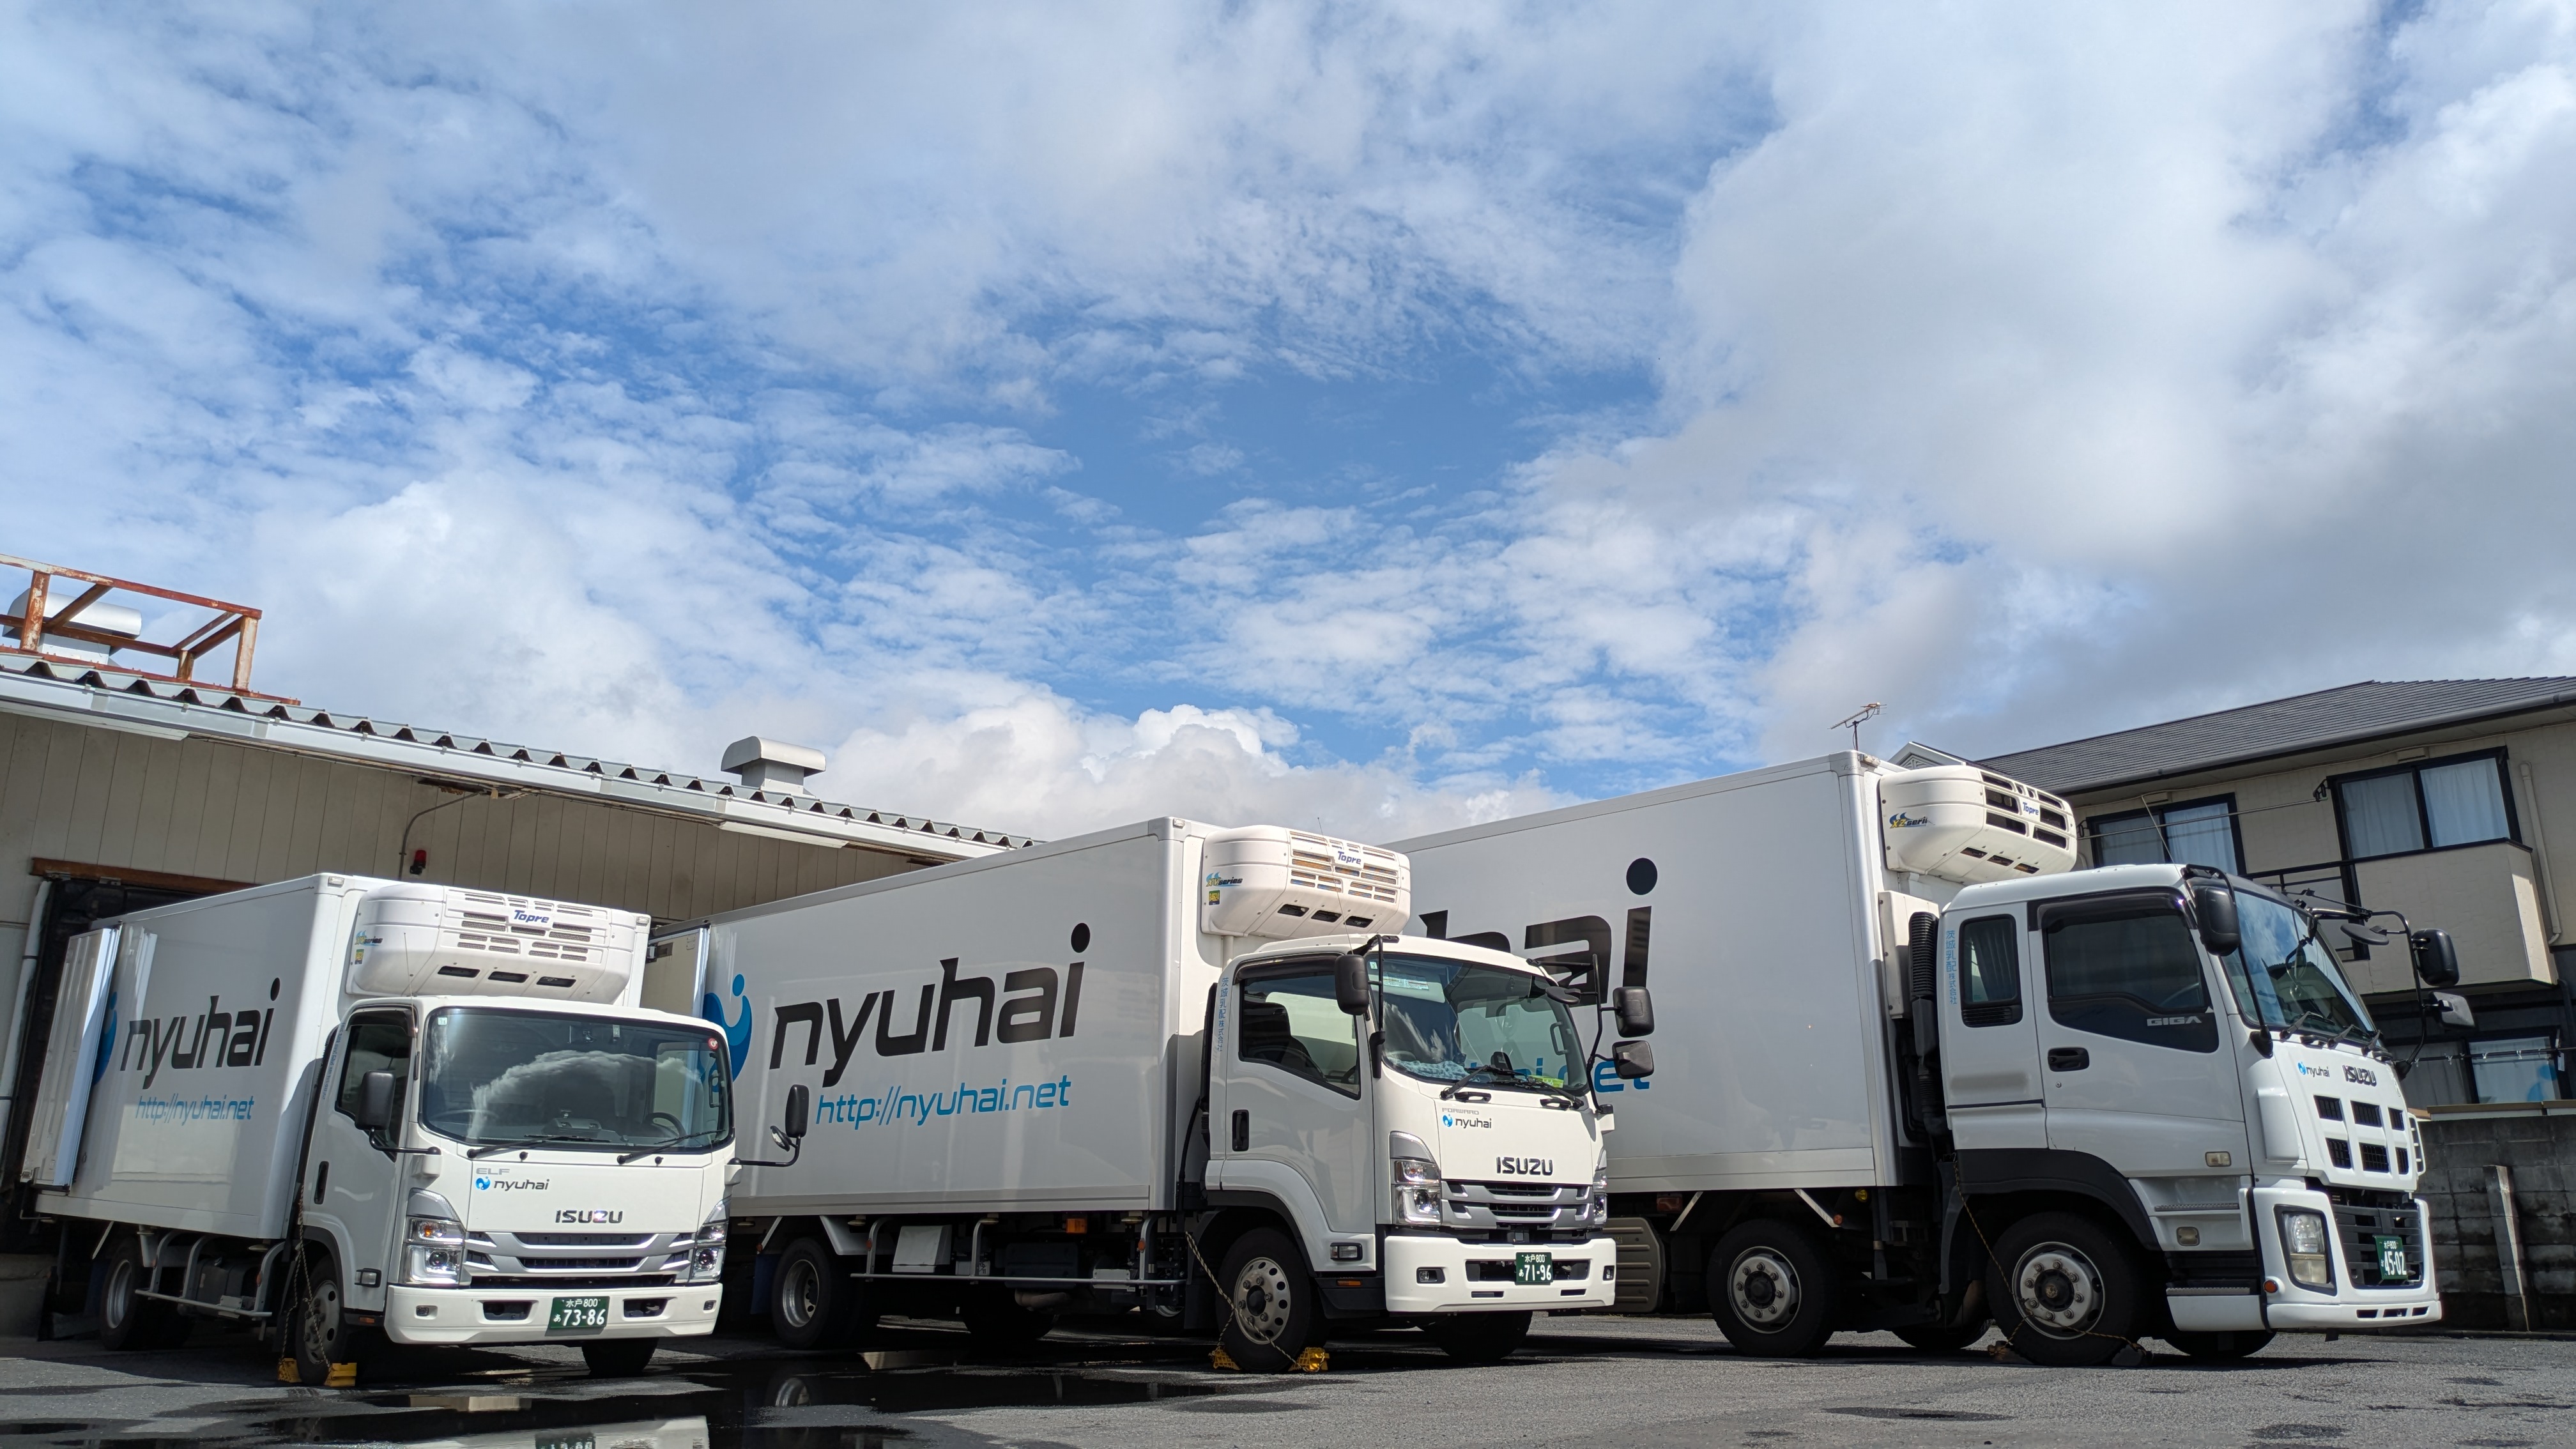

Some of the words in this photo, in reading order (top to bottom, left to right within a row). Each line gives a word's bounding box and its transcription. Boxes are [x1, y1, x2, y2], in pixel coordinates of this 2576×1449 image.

[2023, 802, 2039, 815] Topre
[1338, 851, 1361, 865] Topre
[514, 910, 549, 923] Topre
[1945, 930, 1957, 1004] 茨城乳配株式会社
[769, 923, 1091, 1088] nyuhai
[2147, 1016, 2202, 1027] GIGA
[119, 977, 280, 1090] nyuhai
[2306, 1066, 2330, 1077] nyuhai
[2342, 1064, 2377, 1087] ISUZU
[135, 1093, 255, 1126] http://nyuhai.net
[816, 1075, 1071, 1130] http://nyuhai.net
[1455, 1118, 1492, 1129] nyuhai
[1496, 1156, 1553, 1176] ISUZU
[494, 1179, 549, 1192] nyuhai
[555, 1209, 623, 1223] ISUZU
[563, 1309, 606, 1326] 73-86
